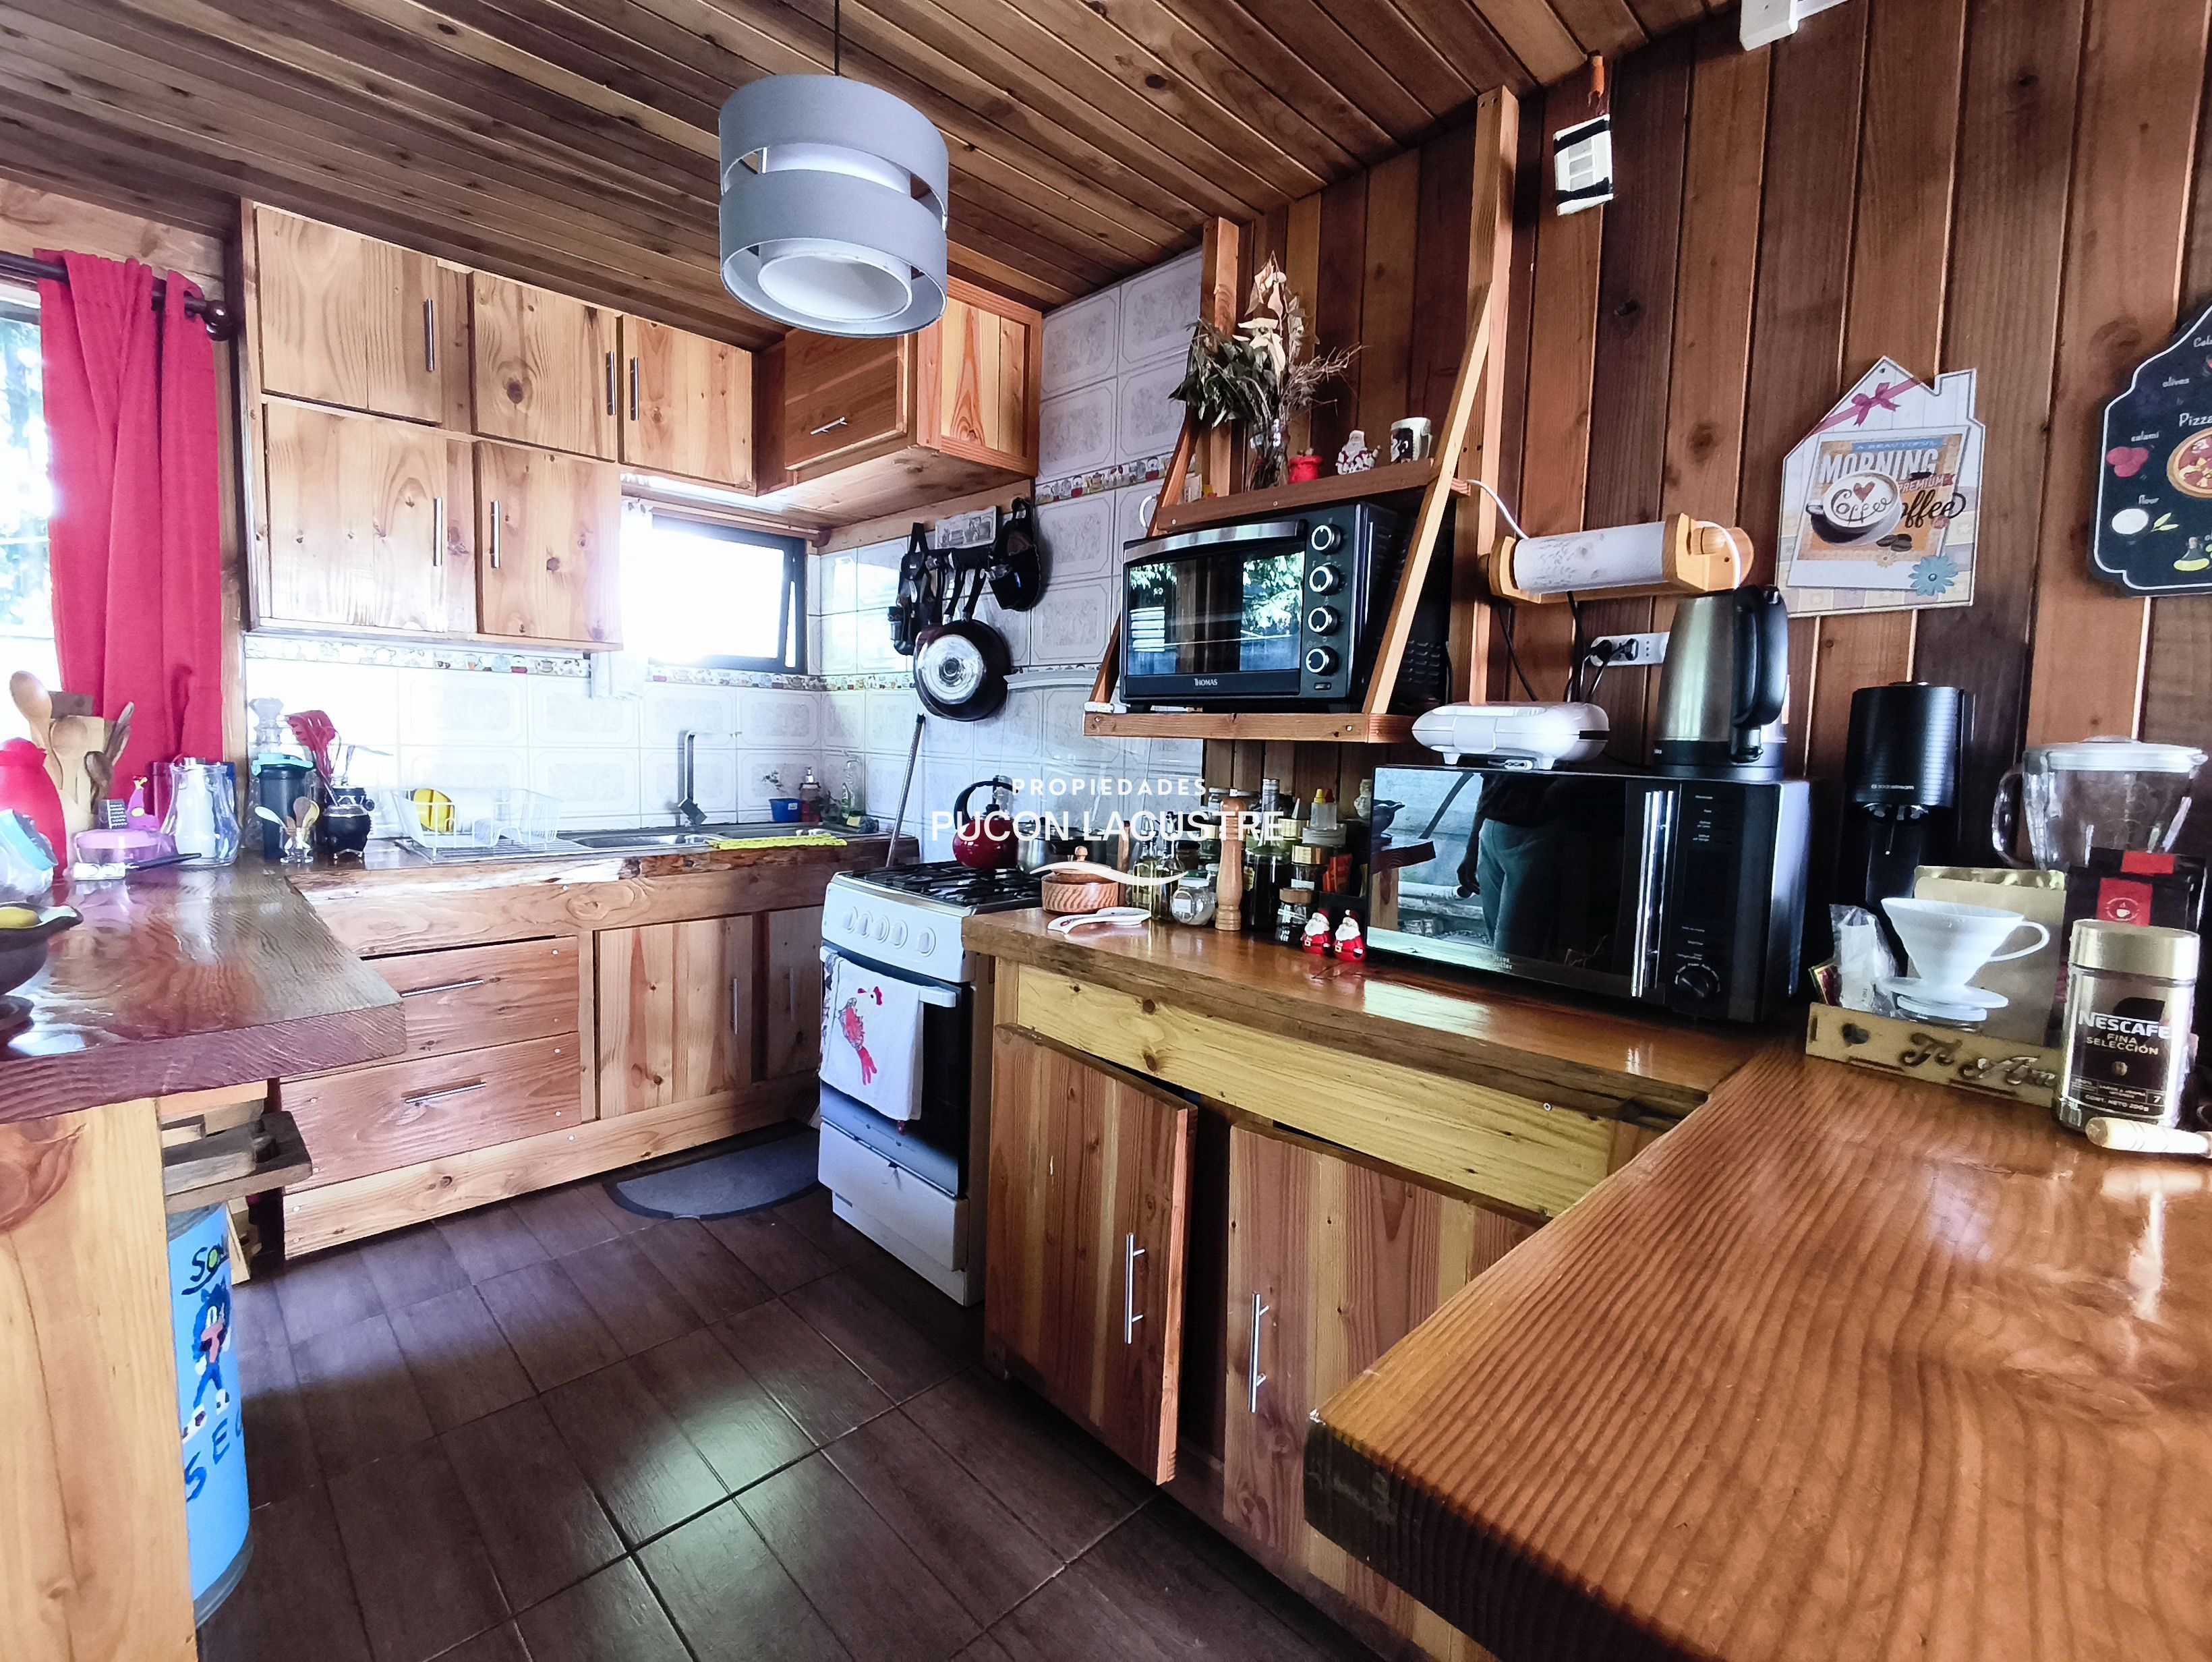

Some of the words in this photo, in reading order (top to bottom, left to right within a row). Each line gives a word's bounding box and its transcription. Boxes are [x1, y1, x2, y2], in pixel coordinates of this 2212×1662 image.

[1820, 449, 1939, 484] MORNING
[1898, 474, 1944, 494] PREMIUM
[1193, 677, 1218, 686] THOMAS
[2086, 1036, 2159, 1056] SELECCIÓN
[2106, 1033, 2137, 1045] FINA
